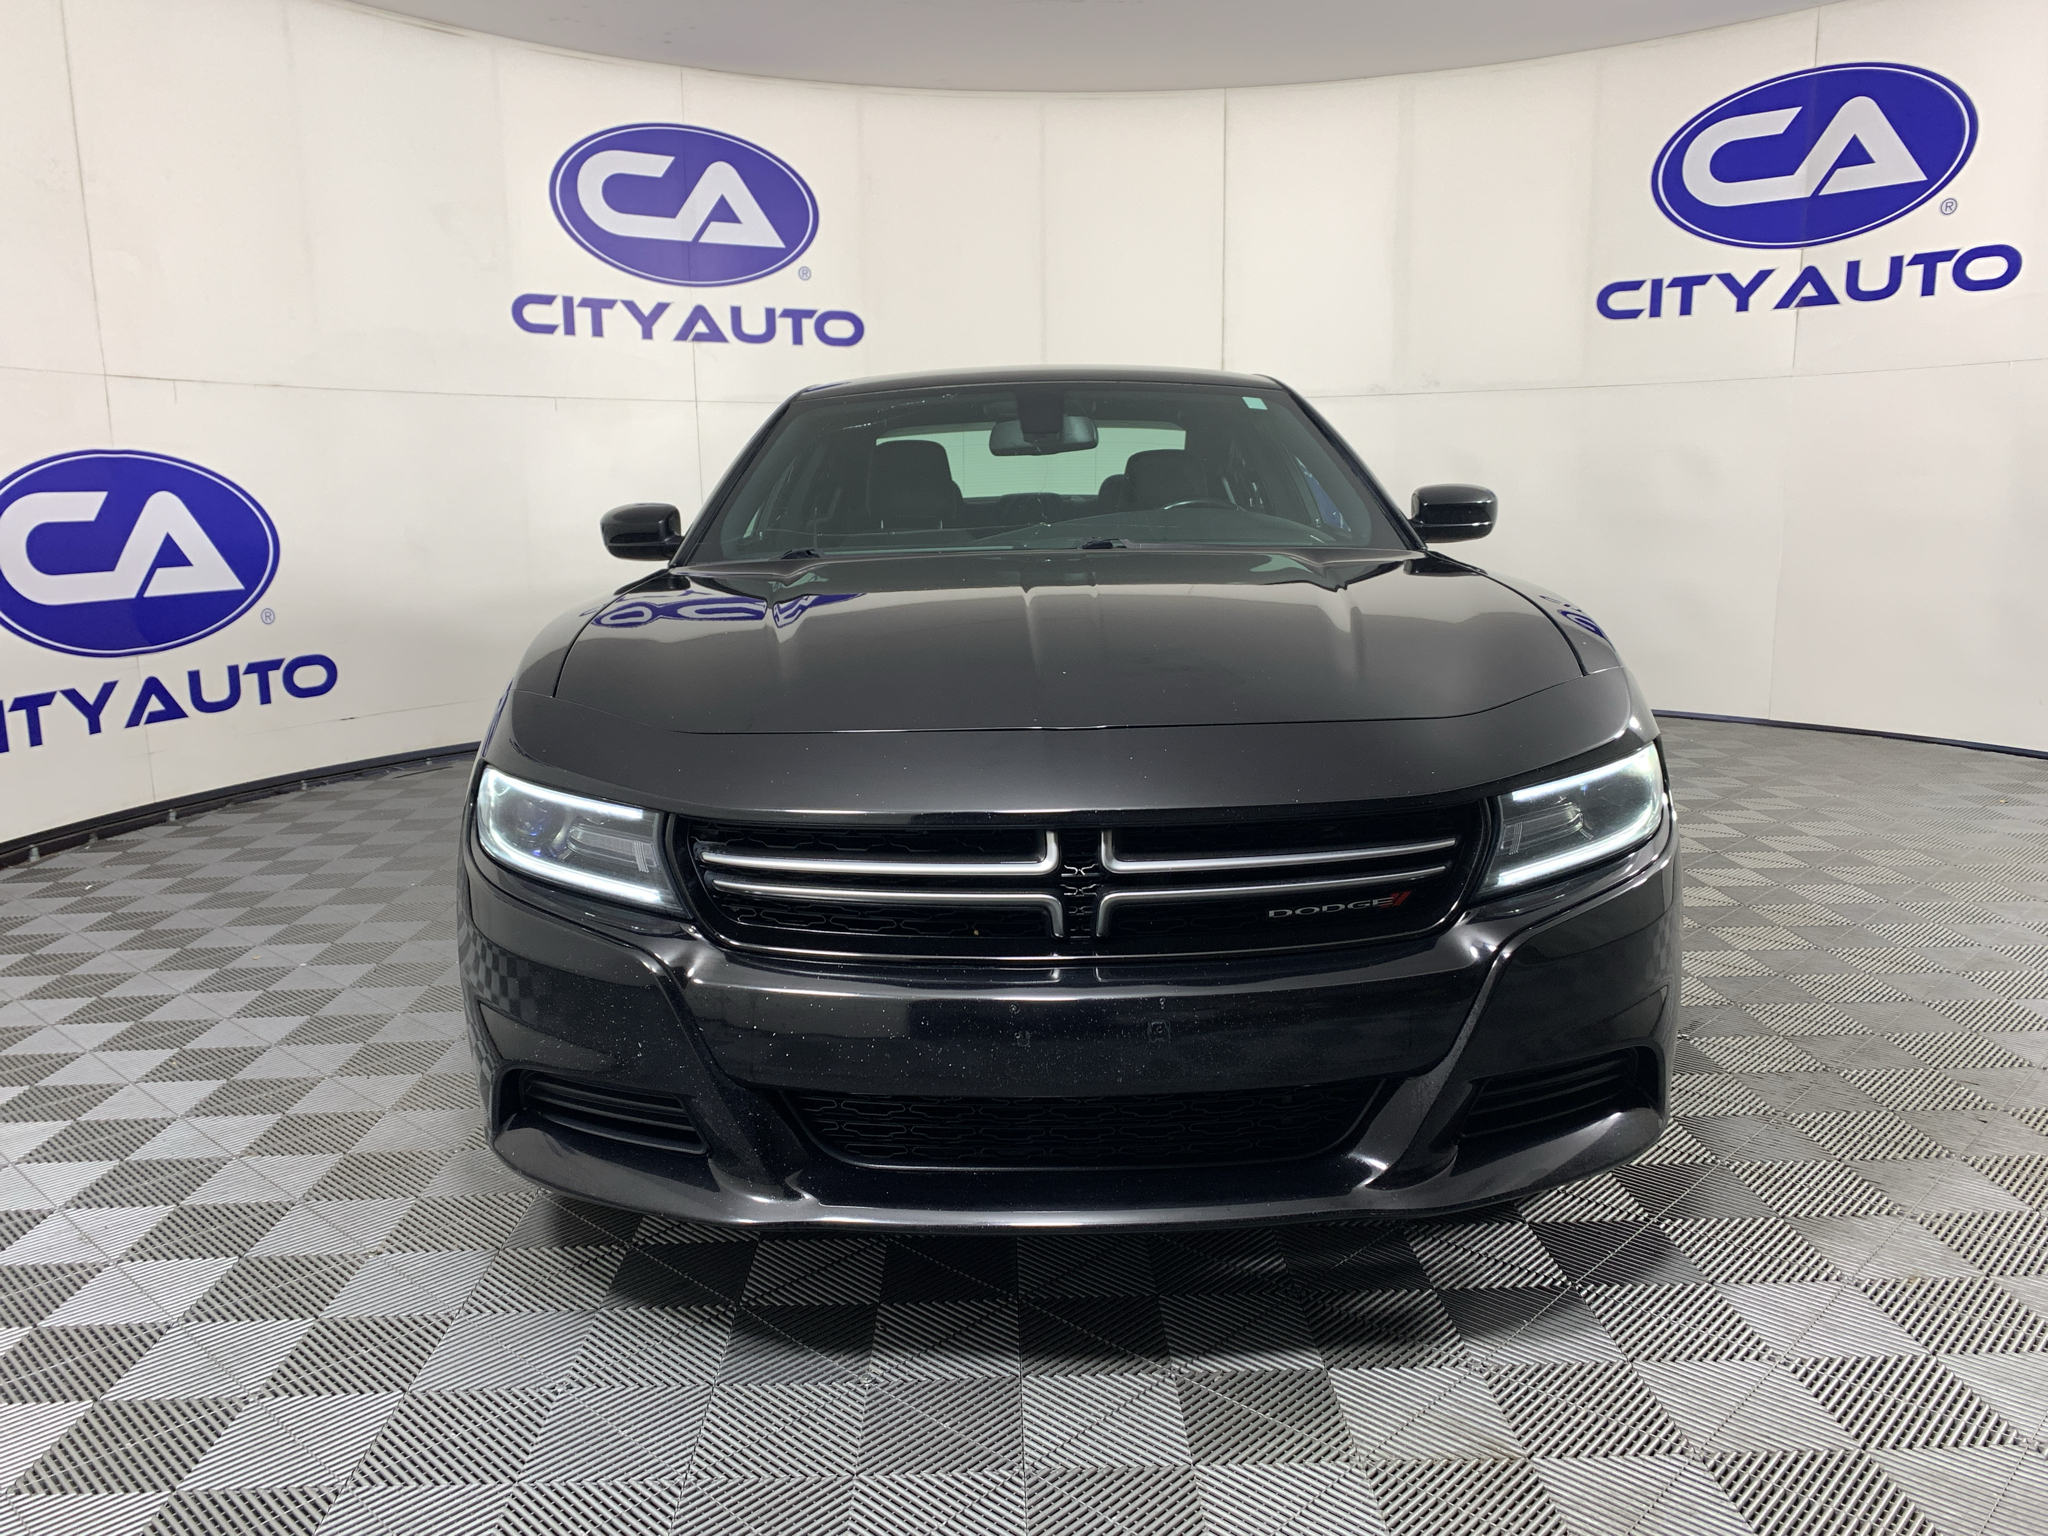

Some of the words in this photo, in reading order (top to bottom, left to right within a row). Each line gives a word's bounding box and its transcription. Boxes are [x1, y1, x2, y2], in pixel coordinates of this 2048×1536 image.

[576, 149, 787, 249] CA
[1681, 95, 1928, 207] CA
[0, 489, 246, 606] CA
[1268, 896, 1394, 918] DODGE
